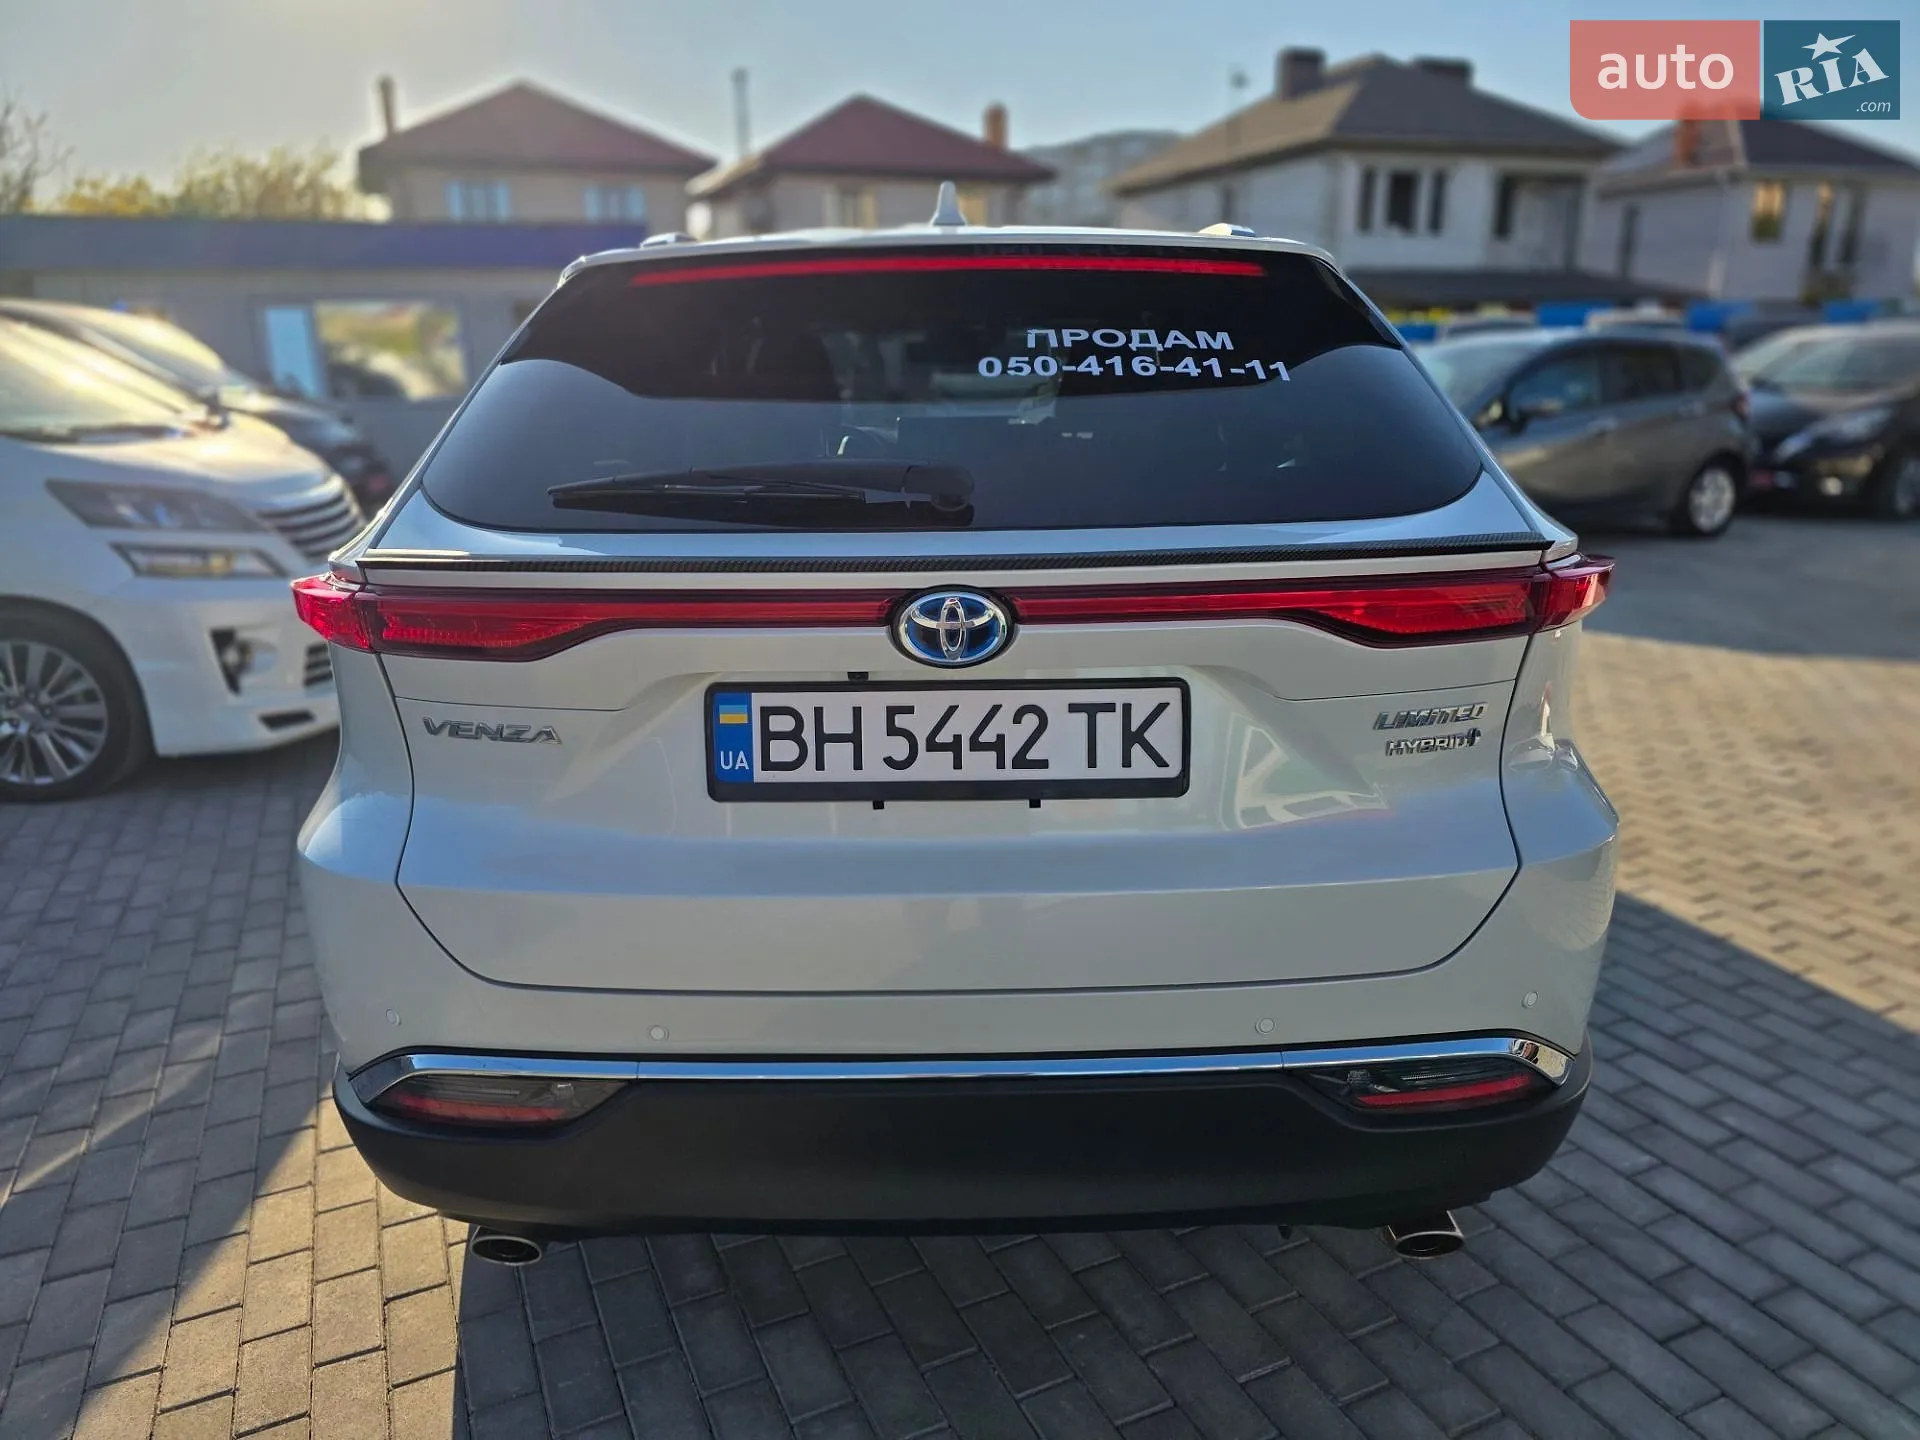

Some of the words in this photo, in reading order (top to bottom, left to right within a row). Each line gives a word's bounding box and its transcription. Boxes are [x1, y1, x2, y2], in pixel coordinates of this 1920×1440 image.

[1026, 328, 1235, 352] ПРОДАМ
[977, 355, 1292, 382] 050-416-41-11
[422, 716, 563, 745] VENZA
[1374, 702, 1490, 731] LIMITED
[758, 705, 864, 771] BH
[882, 703, 1050, 771] 5442
[1067, 702, 1172, 770] TK
[720, 751, 749, 771] UA
